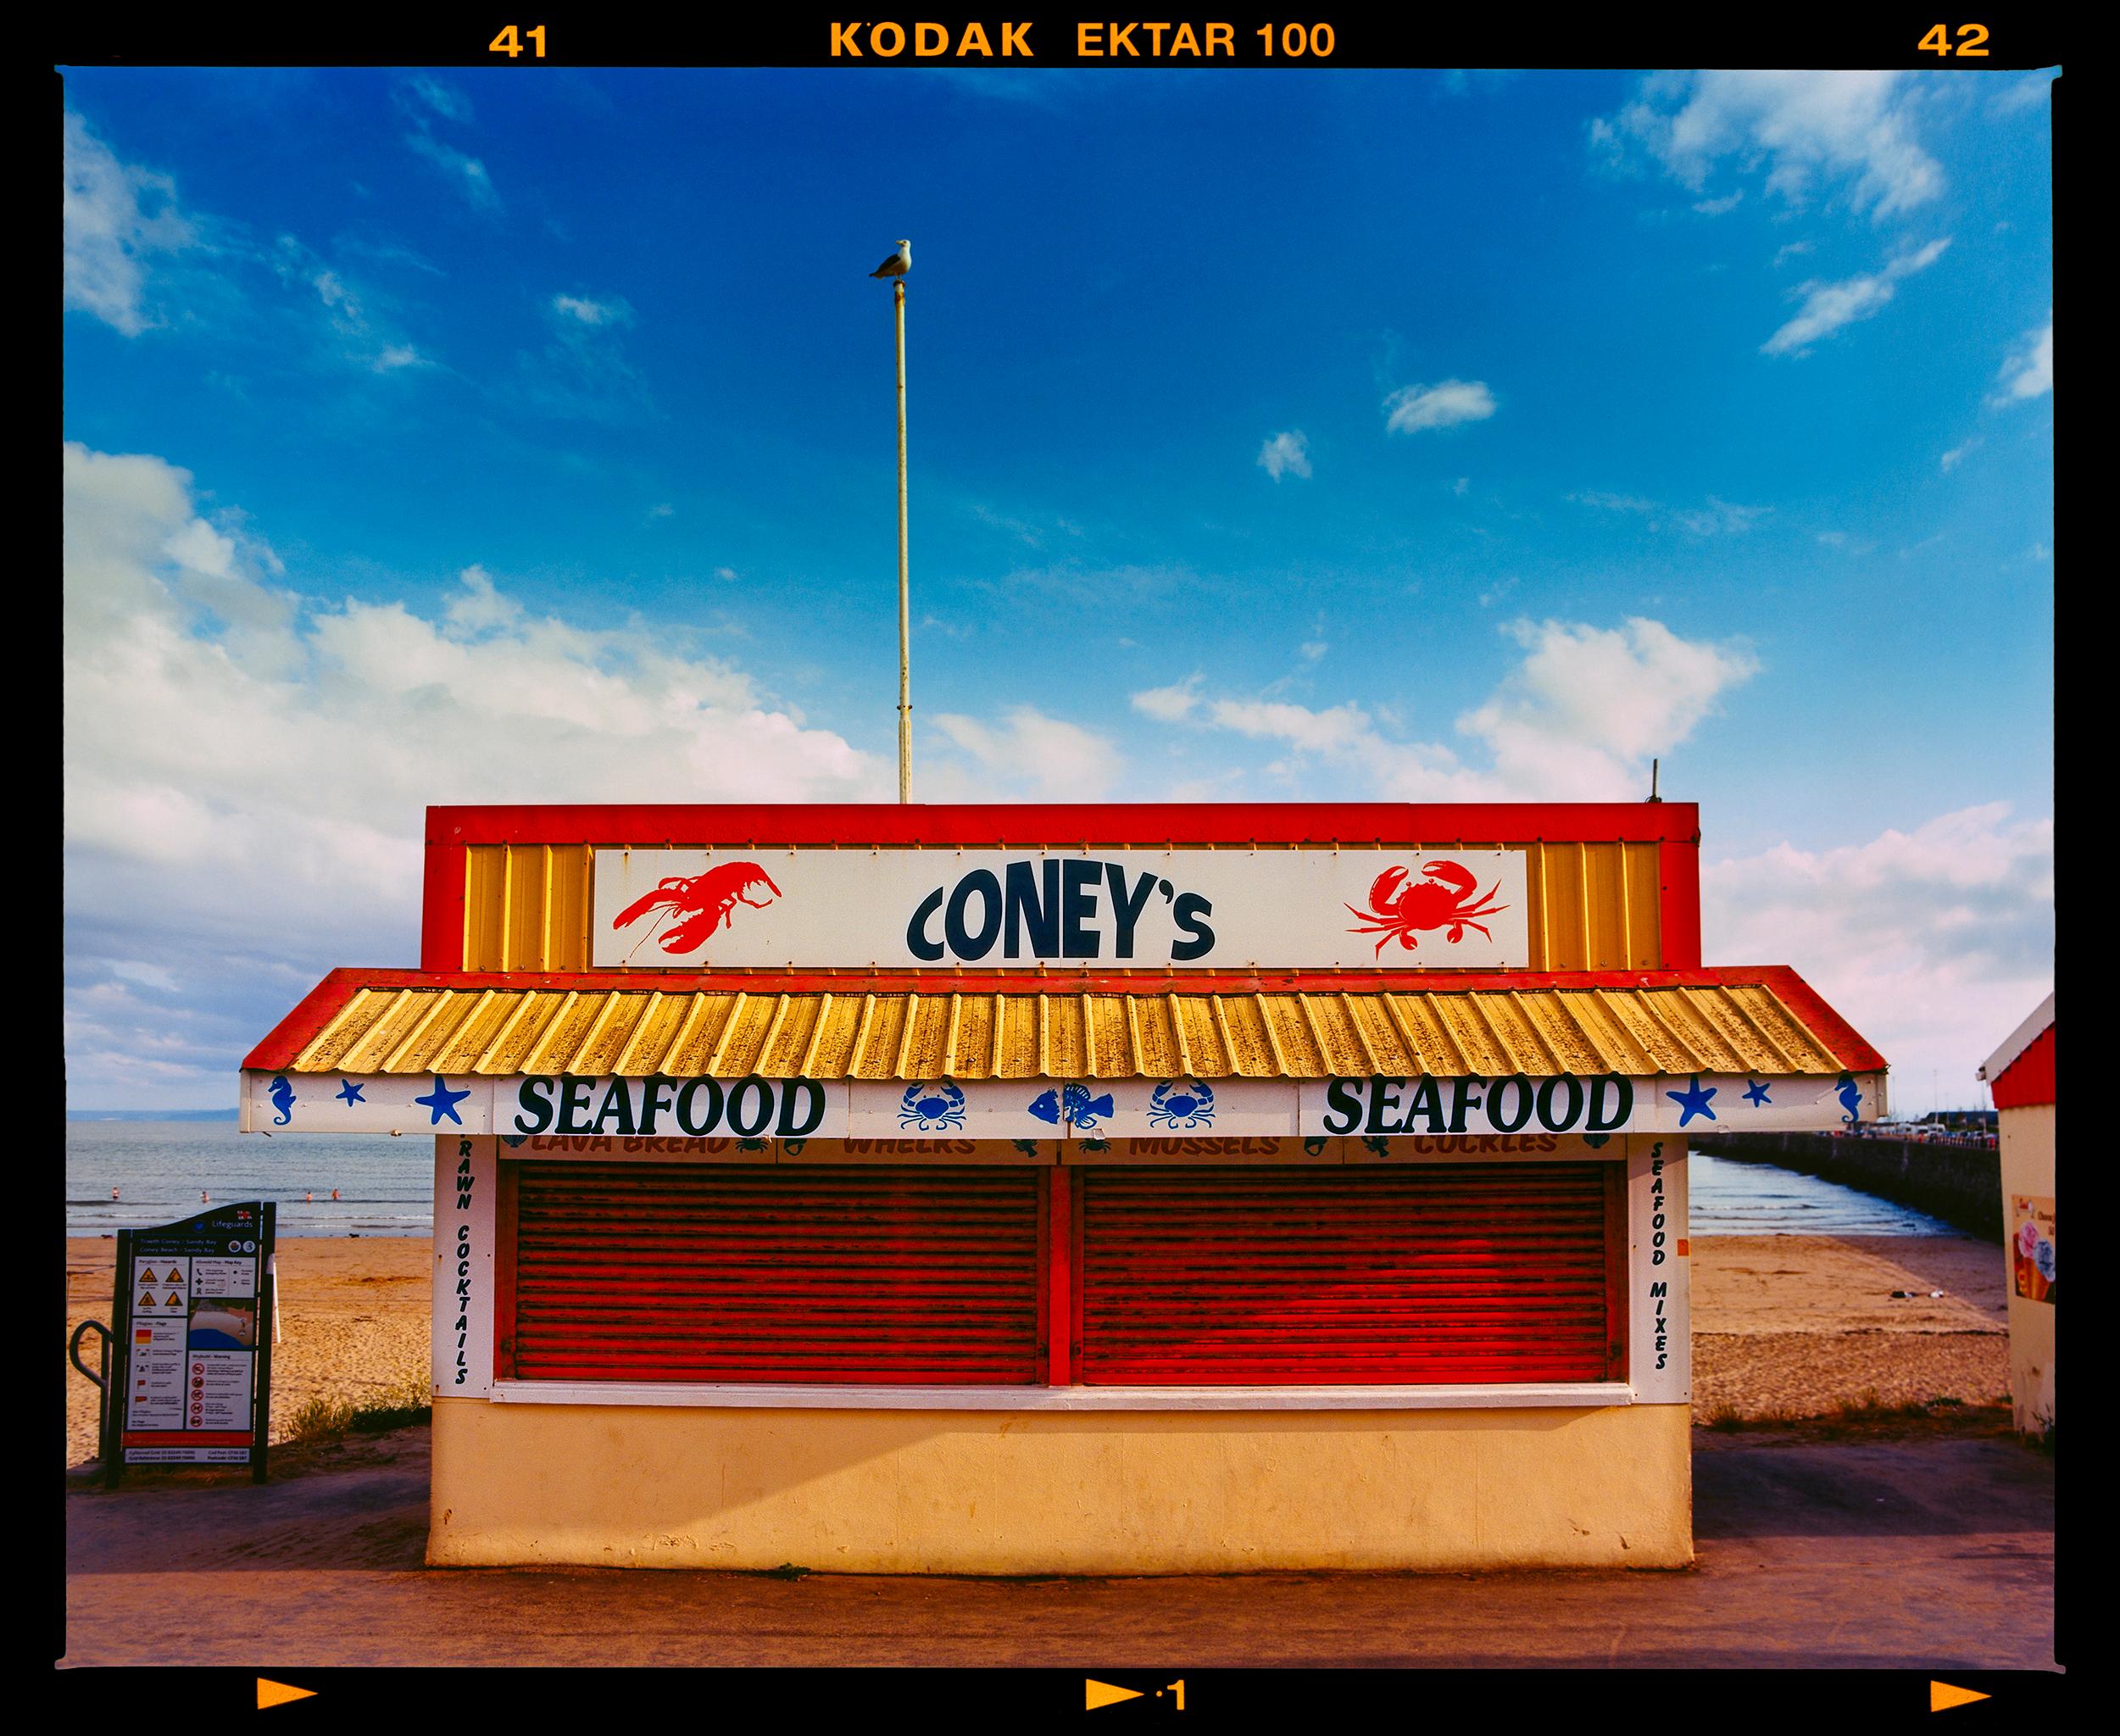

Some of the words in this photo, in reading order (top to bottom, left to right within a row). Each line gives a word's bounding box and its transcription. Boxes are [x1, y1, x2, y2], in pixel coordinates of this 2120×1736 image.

[515, 1075, 826, 1137] SEAFOOD
[1323, 1073, 1634, 1135] SEAFOOD
[456, 1134, 475, 1210] RAWN
[1129, 1137, 1280, 1155] MUSSELS
[1414, 1134, 1558, 1154] COCKLES
[212, 1219, 253, 1230] Lifeguards
[1650, 1142, 1666, 1266] SEAFOOD
[455, 1225, 471, 1384] COCKTAILS
[1650, 1282, 1667, 1370] MIXES
